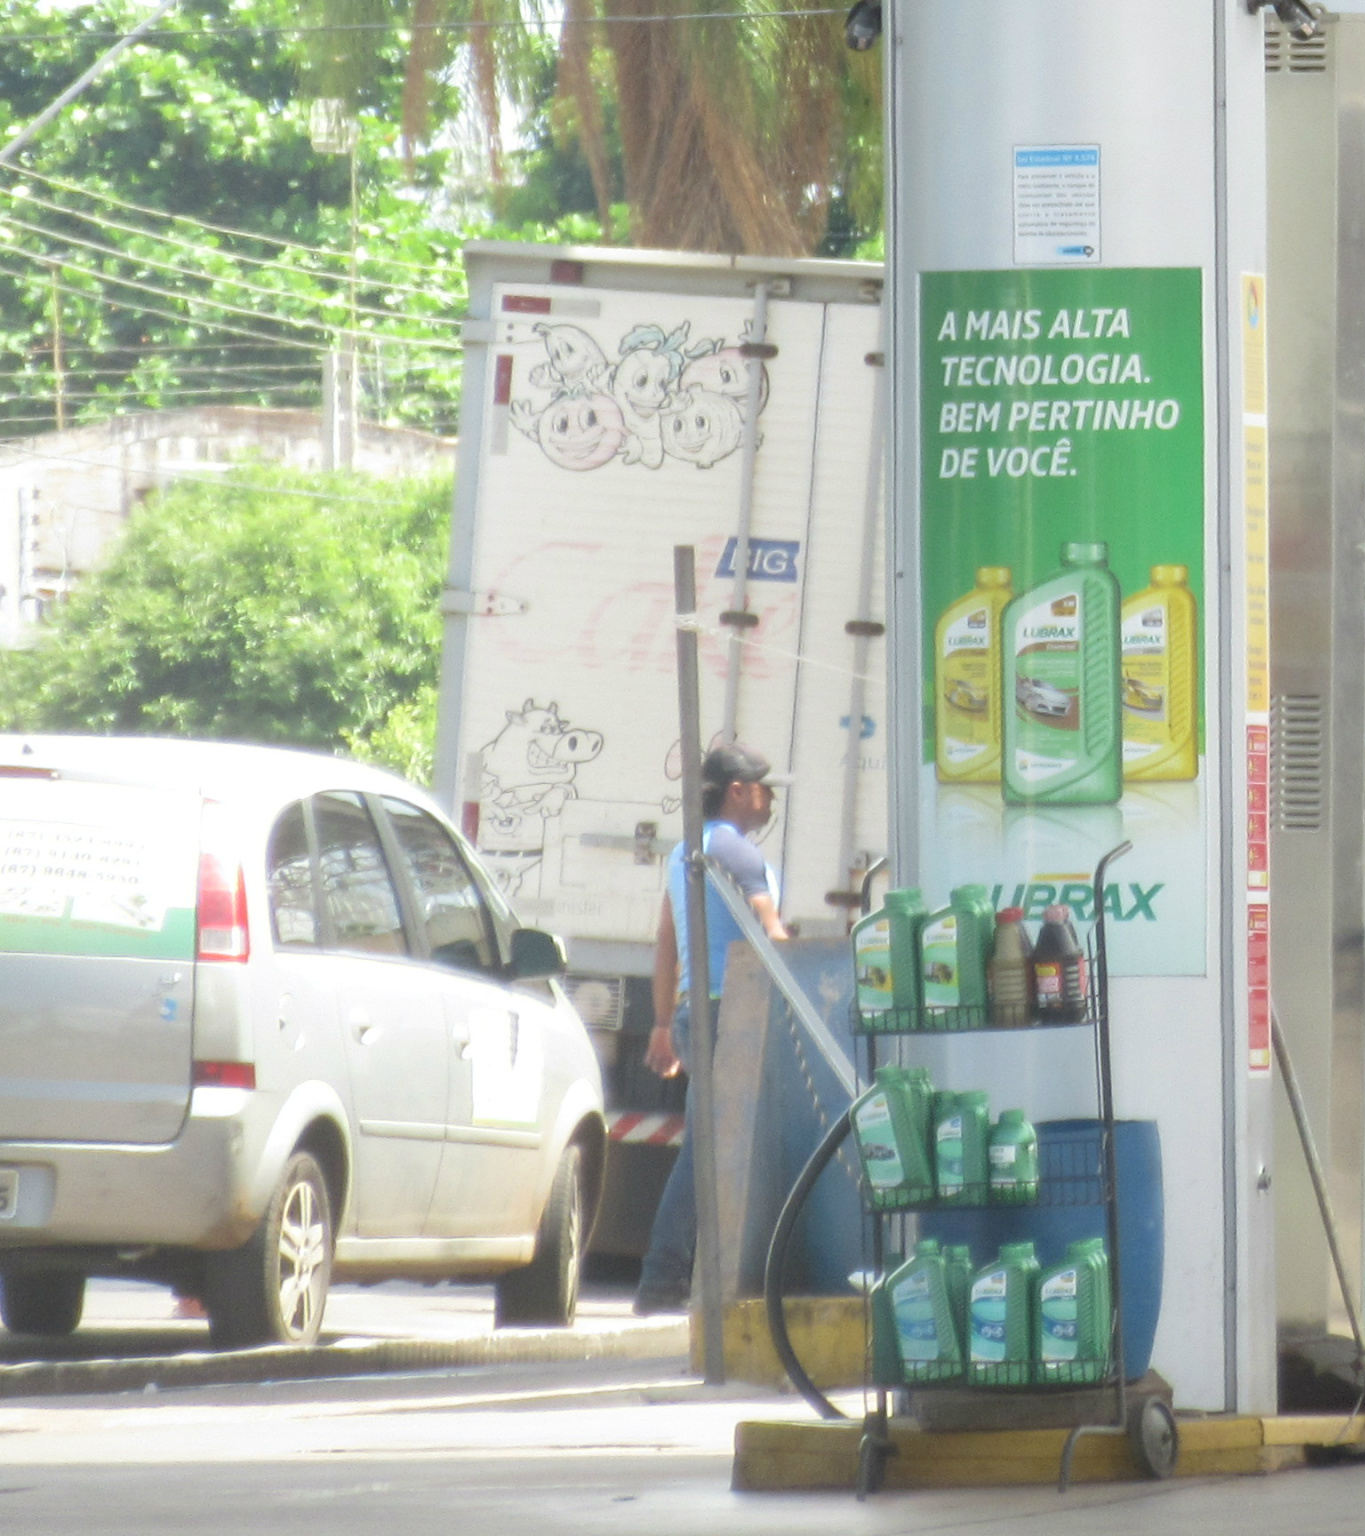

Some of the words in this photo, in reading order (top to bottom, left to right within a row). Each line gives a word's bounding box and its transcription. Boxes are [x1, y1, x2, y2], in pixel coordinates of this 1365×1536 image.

[938, 311, 957, 341] A
[965, 310, 1041, 341] MAIS
[1048, 308, 1131, 339] ALTA
[941, 354, 1152, 386] TECNOLOGIA.
[939, 402, 1001, 434] BEM
[1008, 400, 1180, 432] PERTINHO
[939, 448, 980, 478] DE
[987, 438, 1077, 478] VOCÊ.
